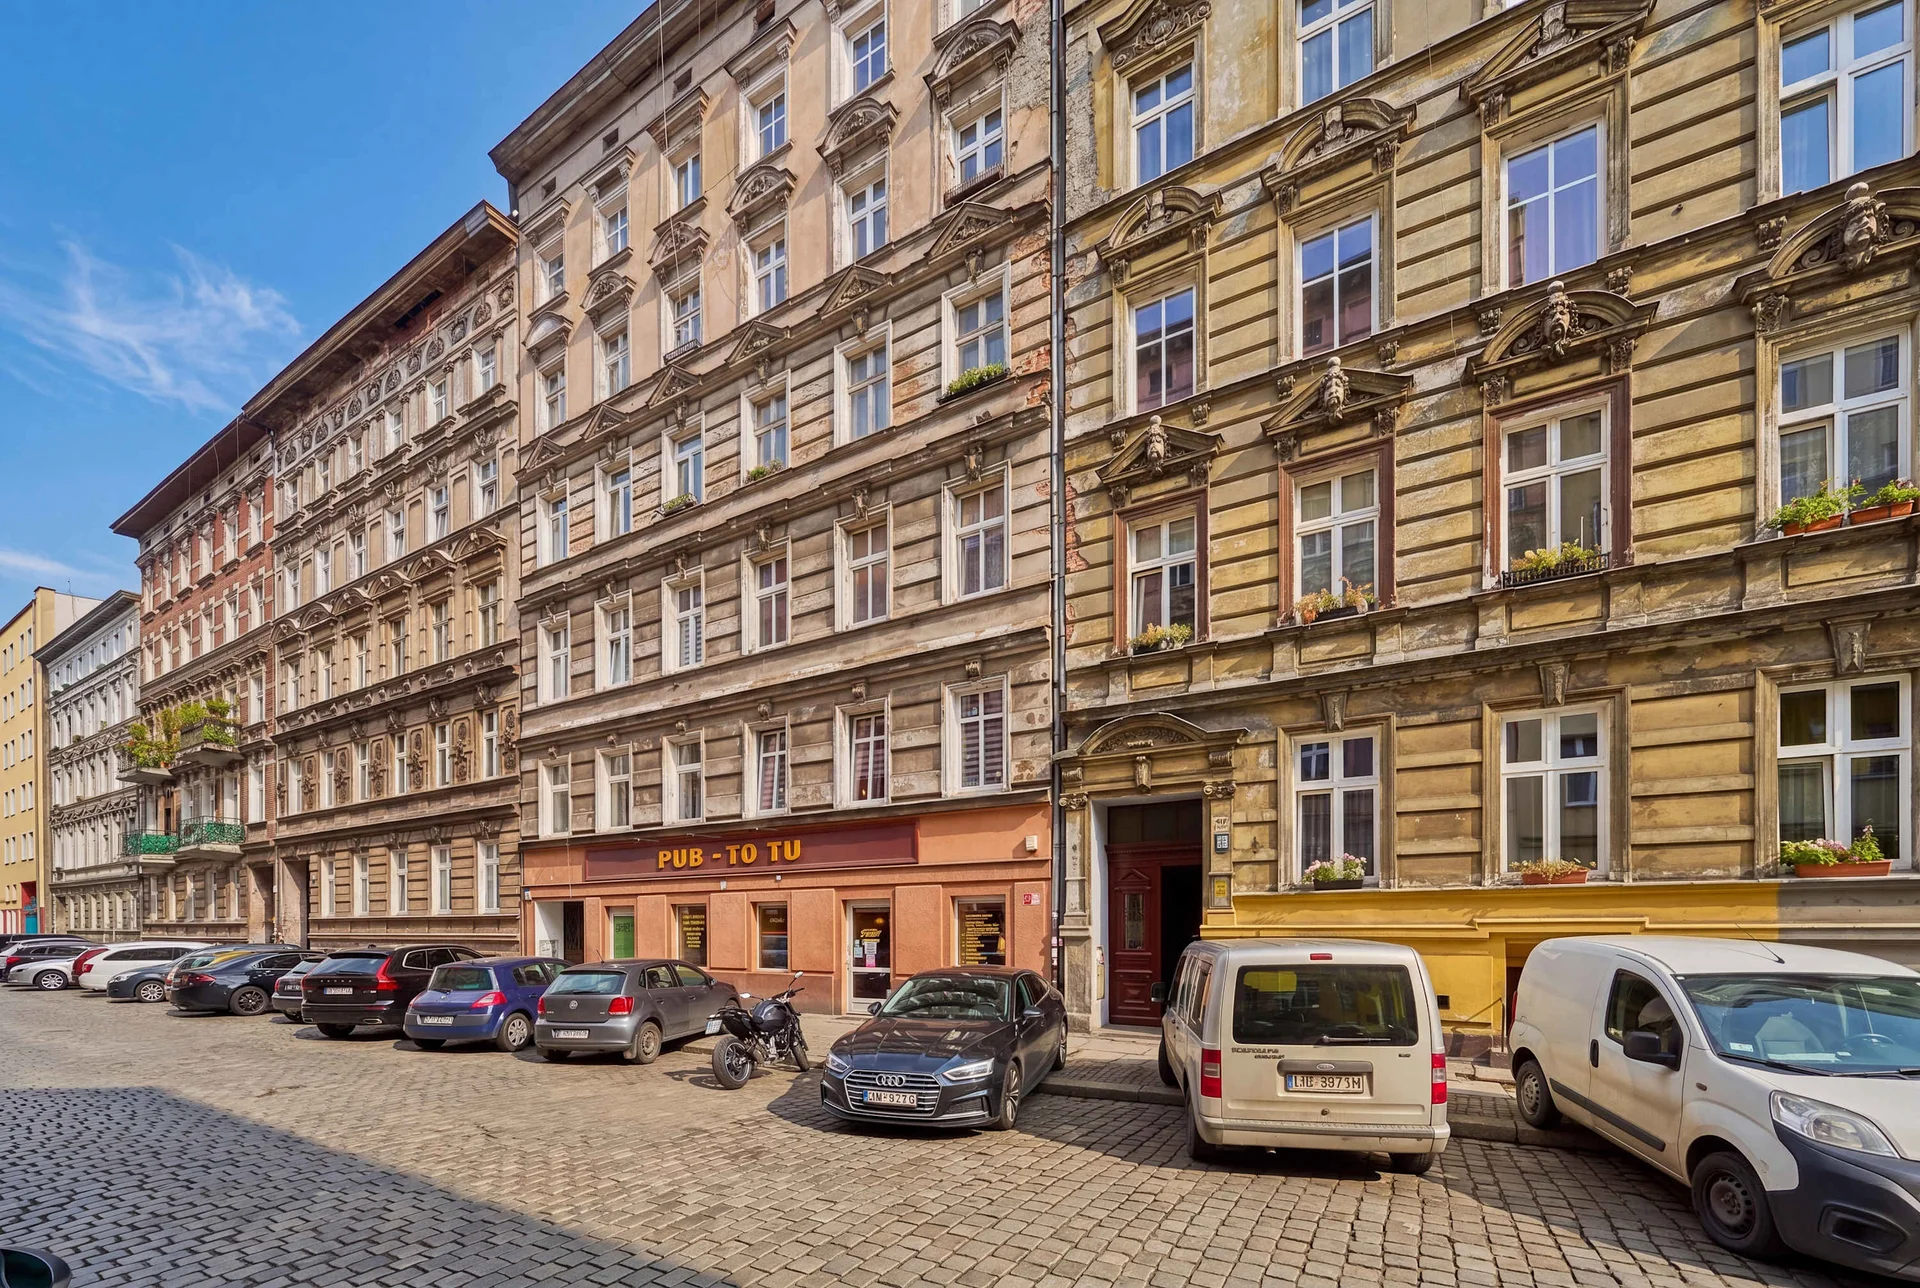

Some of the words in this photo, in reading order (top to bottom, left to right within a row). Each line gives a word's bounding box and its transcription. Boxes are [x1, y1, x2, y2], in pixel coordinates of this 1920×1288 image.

[658, 848, 704, 869] PUB
[725, 843, 758, 865] TO
[766, 839, 801, 862] TU
